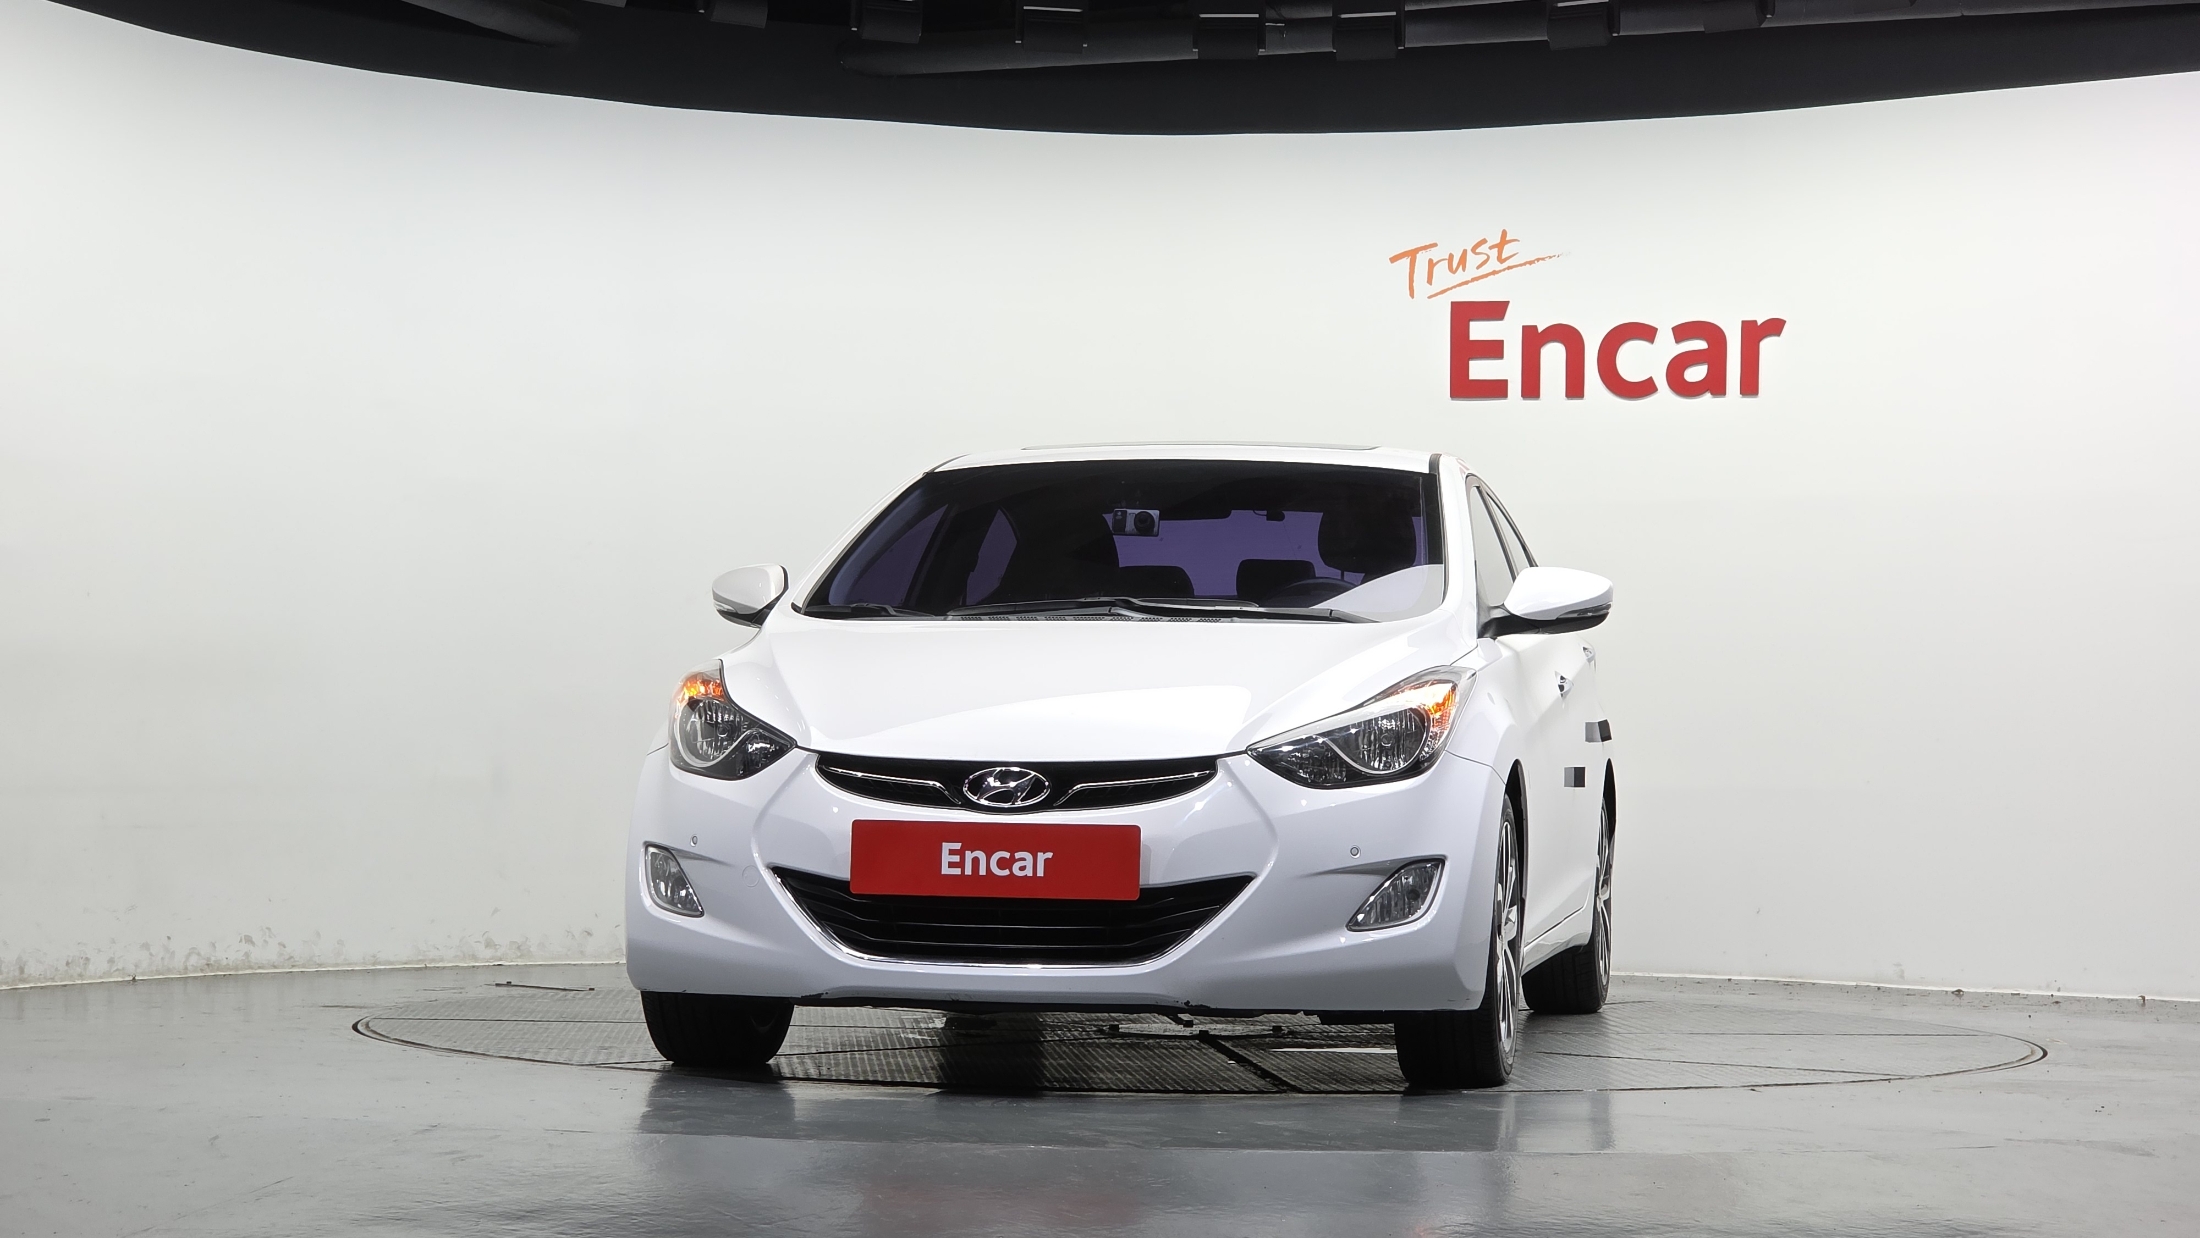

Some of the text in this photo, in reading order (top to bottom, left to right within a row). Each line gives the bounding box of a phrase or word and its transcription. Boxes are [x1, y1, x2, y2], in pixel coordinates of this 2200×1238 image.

[1389, 229, 1520, 299] Trust
[1450, 301, 1787, 400] Encar
[941, 842, 1054, 877] Encar
